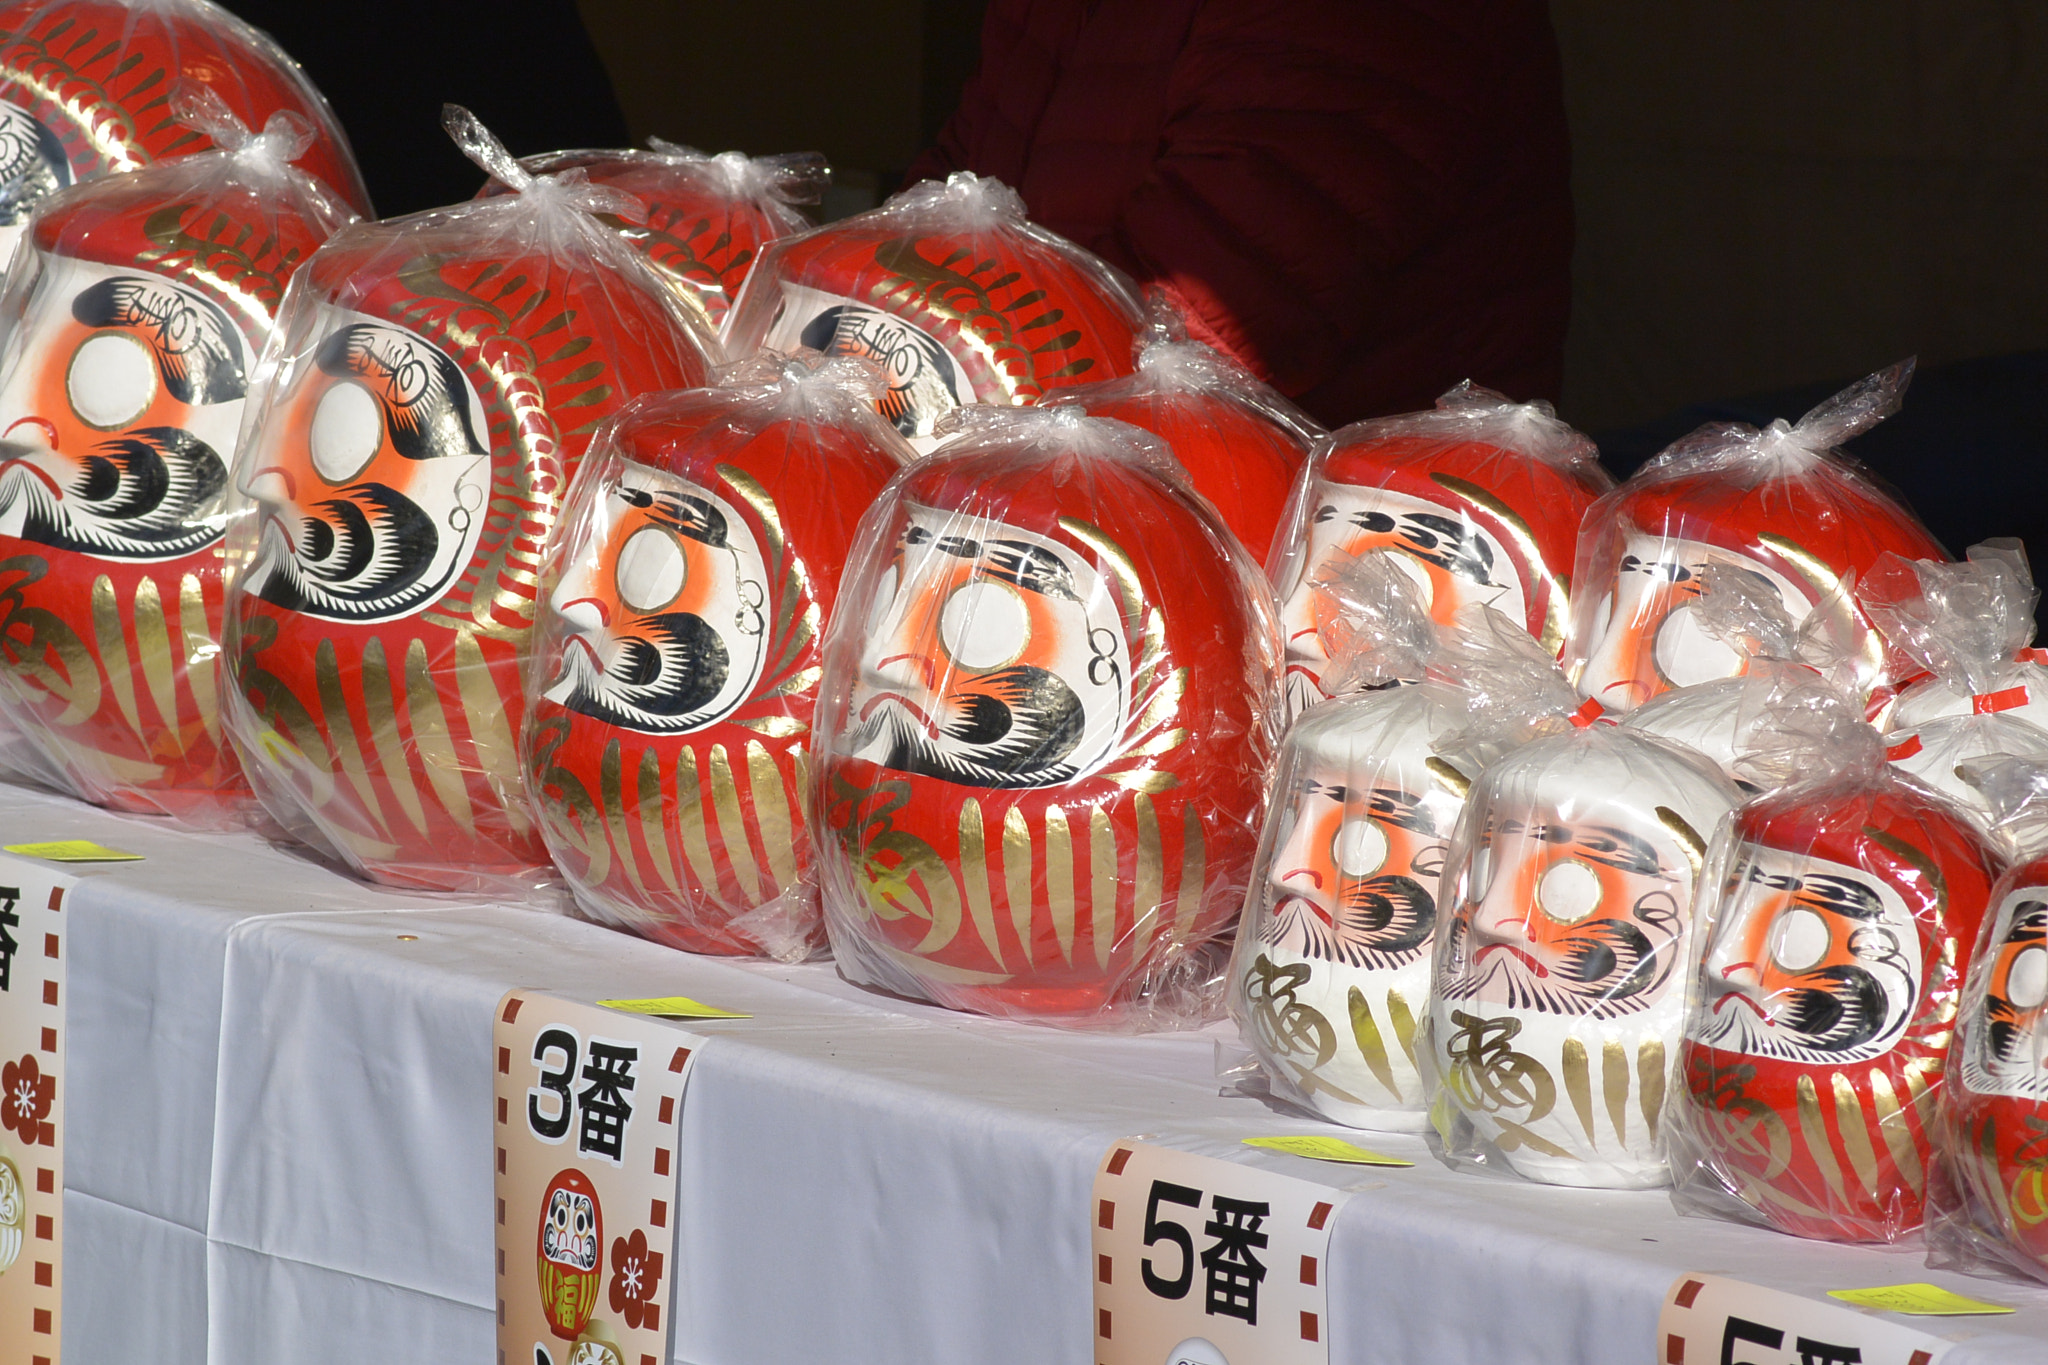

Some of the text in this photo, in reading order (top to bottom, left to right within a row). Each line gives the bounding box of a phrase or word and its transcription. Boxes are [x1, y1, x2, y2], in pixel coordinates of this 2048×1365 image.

[528, 1029, 638, 1162] 3番
[554, 1268, 581, 1330] 福
[1141, 1178, 1271, 1326] 5番
